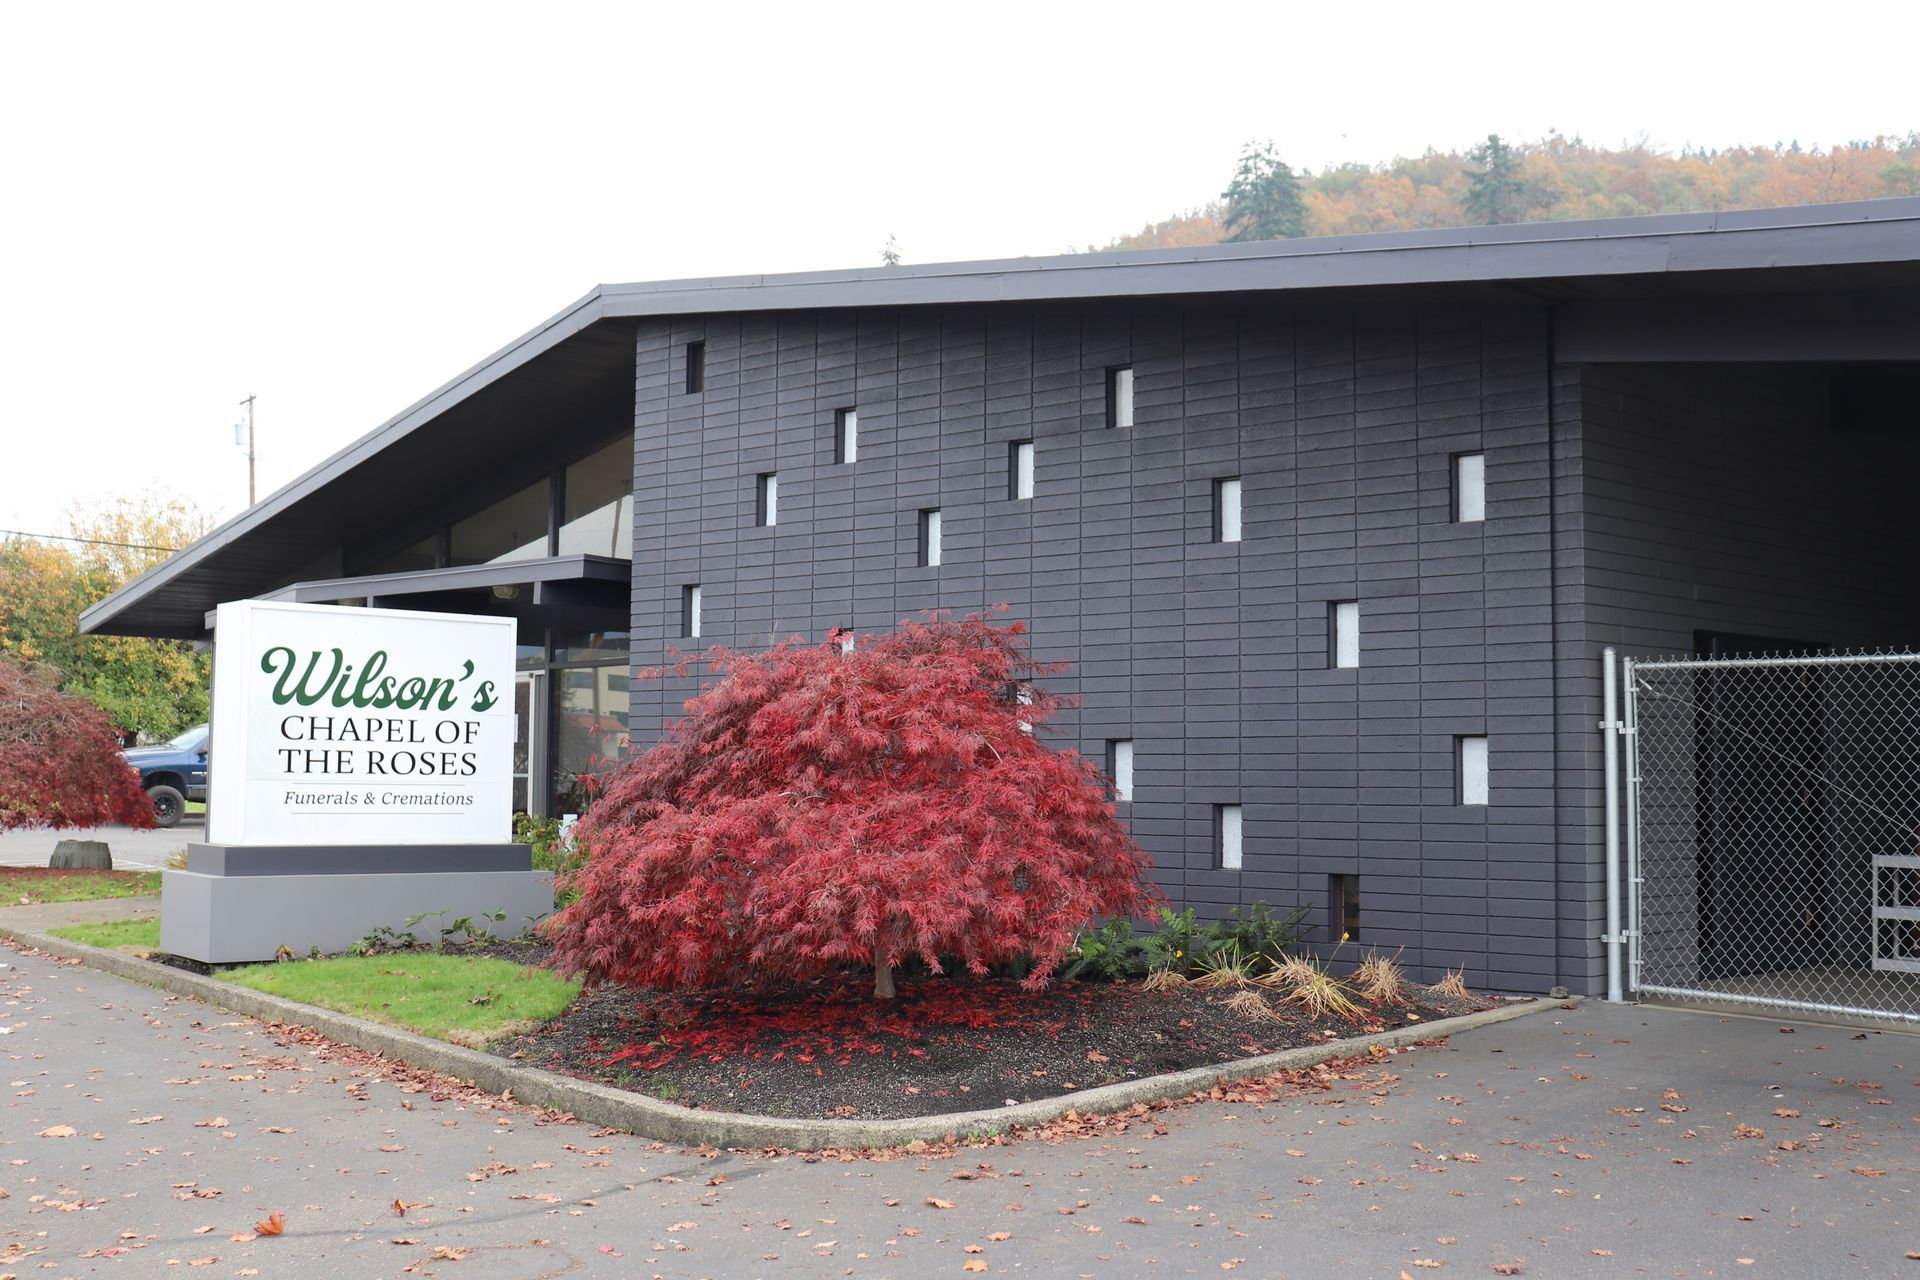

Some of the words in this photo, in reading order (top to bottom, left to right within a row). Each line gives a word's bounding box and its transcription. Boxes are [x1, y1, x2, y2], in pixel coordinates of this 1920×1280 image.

[261, 646, 499, 712] Wilson's
[280, 715, 425, 743] CHAPEL
[435, 719, 480, 744] OF
[278, 748, 354, 774] THE
[366, 751, 477, 776] ROSES
[283, 790, 358, 805] Funerals
[363, 791, 376, 805] &
[381, 791, 474, 806] Cremations
